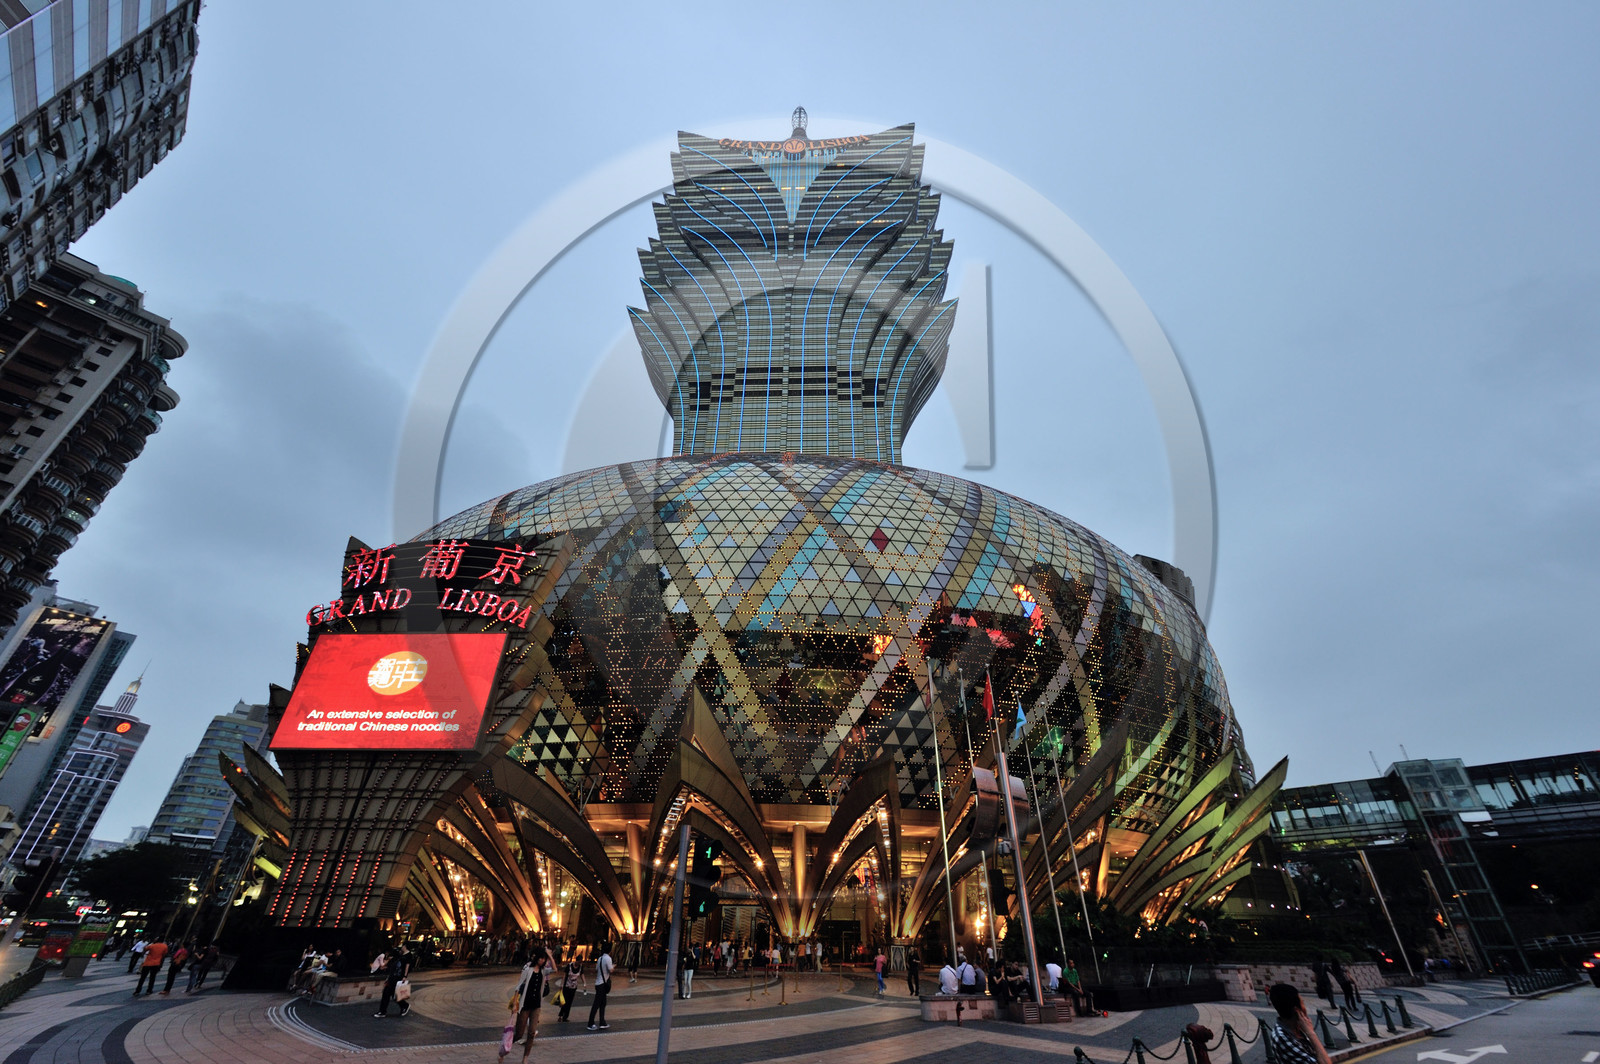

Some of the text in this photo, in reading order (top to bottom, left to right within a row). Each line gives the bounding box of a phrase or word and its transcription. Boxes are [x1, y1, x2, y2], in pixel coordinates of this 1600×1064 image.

[718, 134, 870, 150] GRAND LISBOA
[343, 539, 537, 589] 新葡京
[306, 587, 533, 629] GRAND LISBOA
[306, 709, 457, 719] An extensive selection of
[297, 721, 460, 731] traditional Chinese noodles
